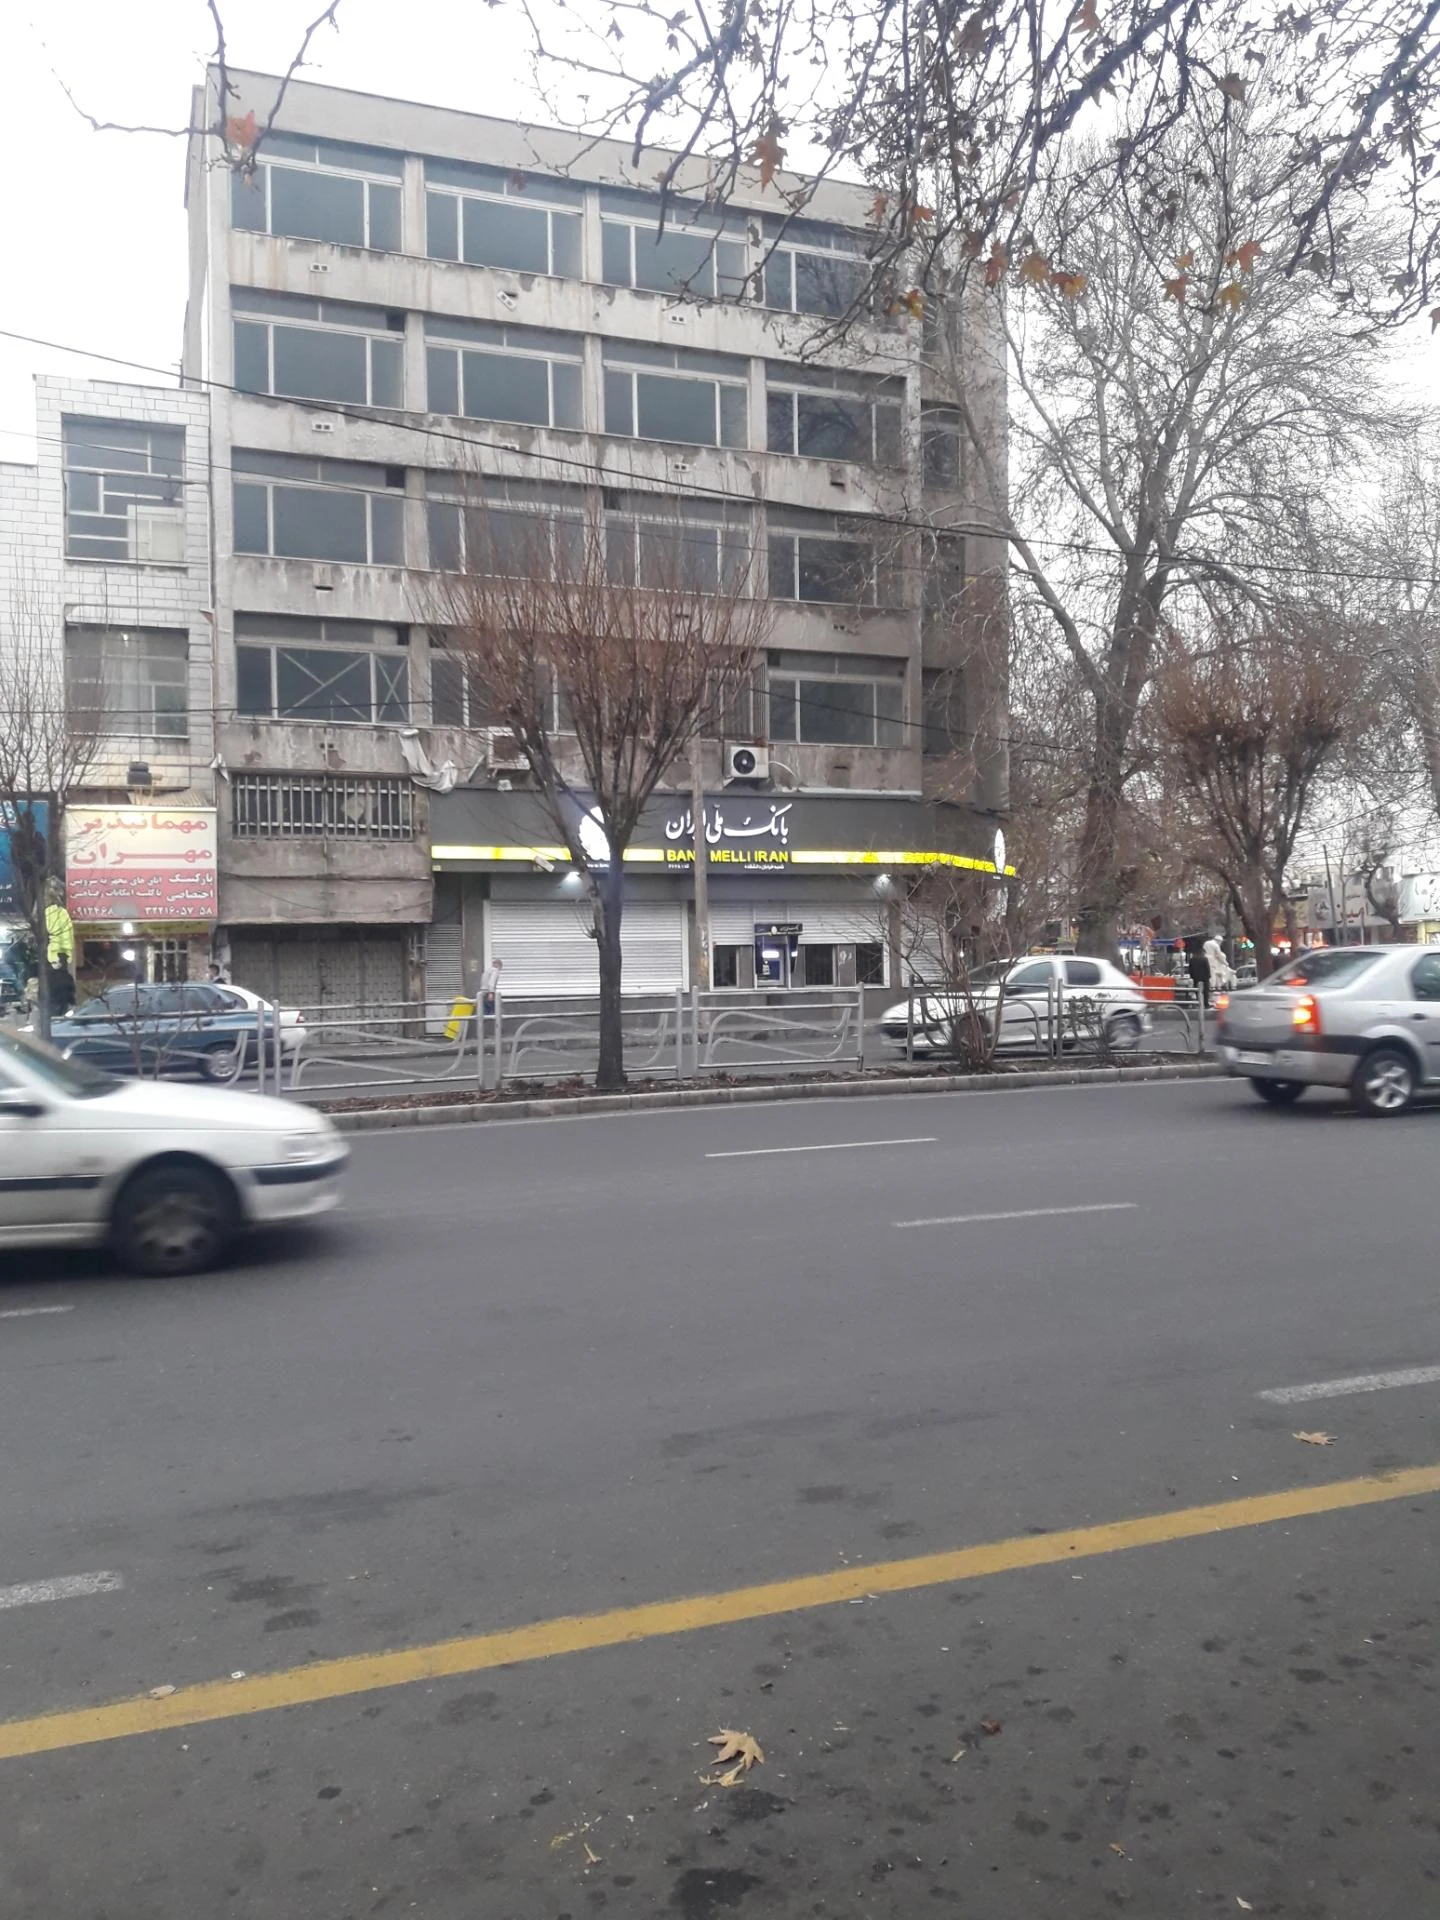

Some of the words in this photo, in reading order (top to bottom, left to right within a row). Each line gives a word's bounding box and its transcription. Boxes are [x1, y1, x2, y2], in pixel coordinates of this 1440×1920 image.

[75, 811, 208, 837] مهمانپذیر
[665, 808, 707, 841] اران
[724, 803, 793, 845] بانک
[72, 842, 212, 865] مهران
[710, 850, 750, 862] MELLI
[754, 850, 789, 862] IRAN
[130, 876, 145, 887] های
[166, 889, 213, 902] اختصاصی
